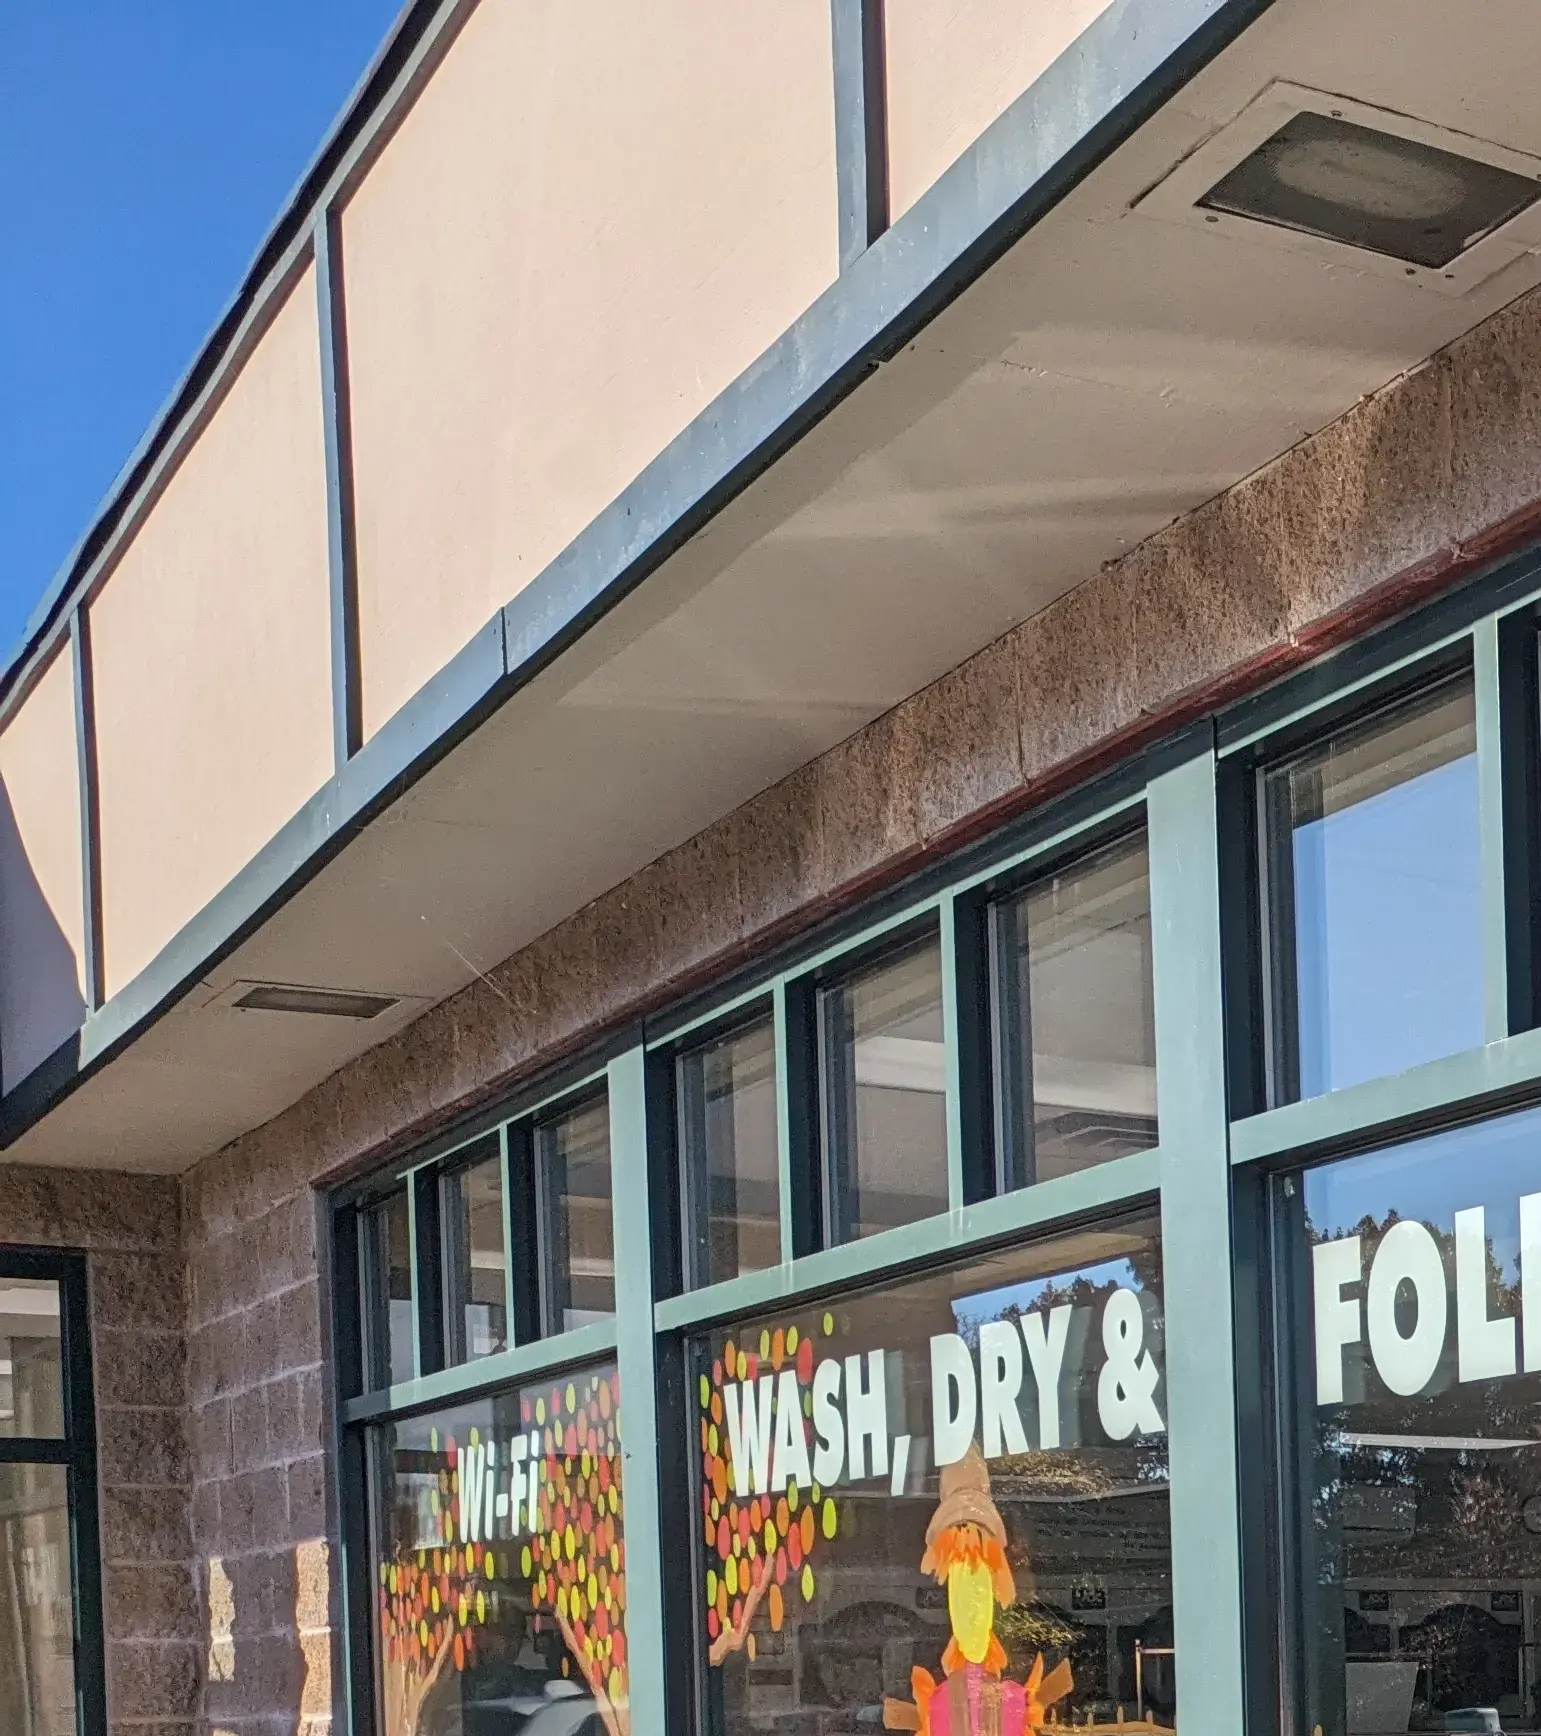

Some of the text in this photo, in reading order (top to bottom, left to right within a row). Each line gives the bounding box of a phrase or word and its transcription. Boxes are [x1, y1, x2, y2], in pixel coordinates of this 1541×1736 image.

[724, 1288, 1167, 1497] WASH, DRY &
[457, 1429, 540, 1544] Wi-Fi
